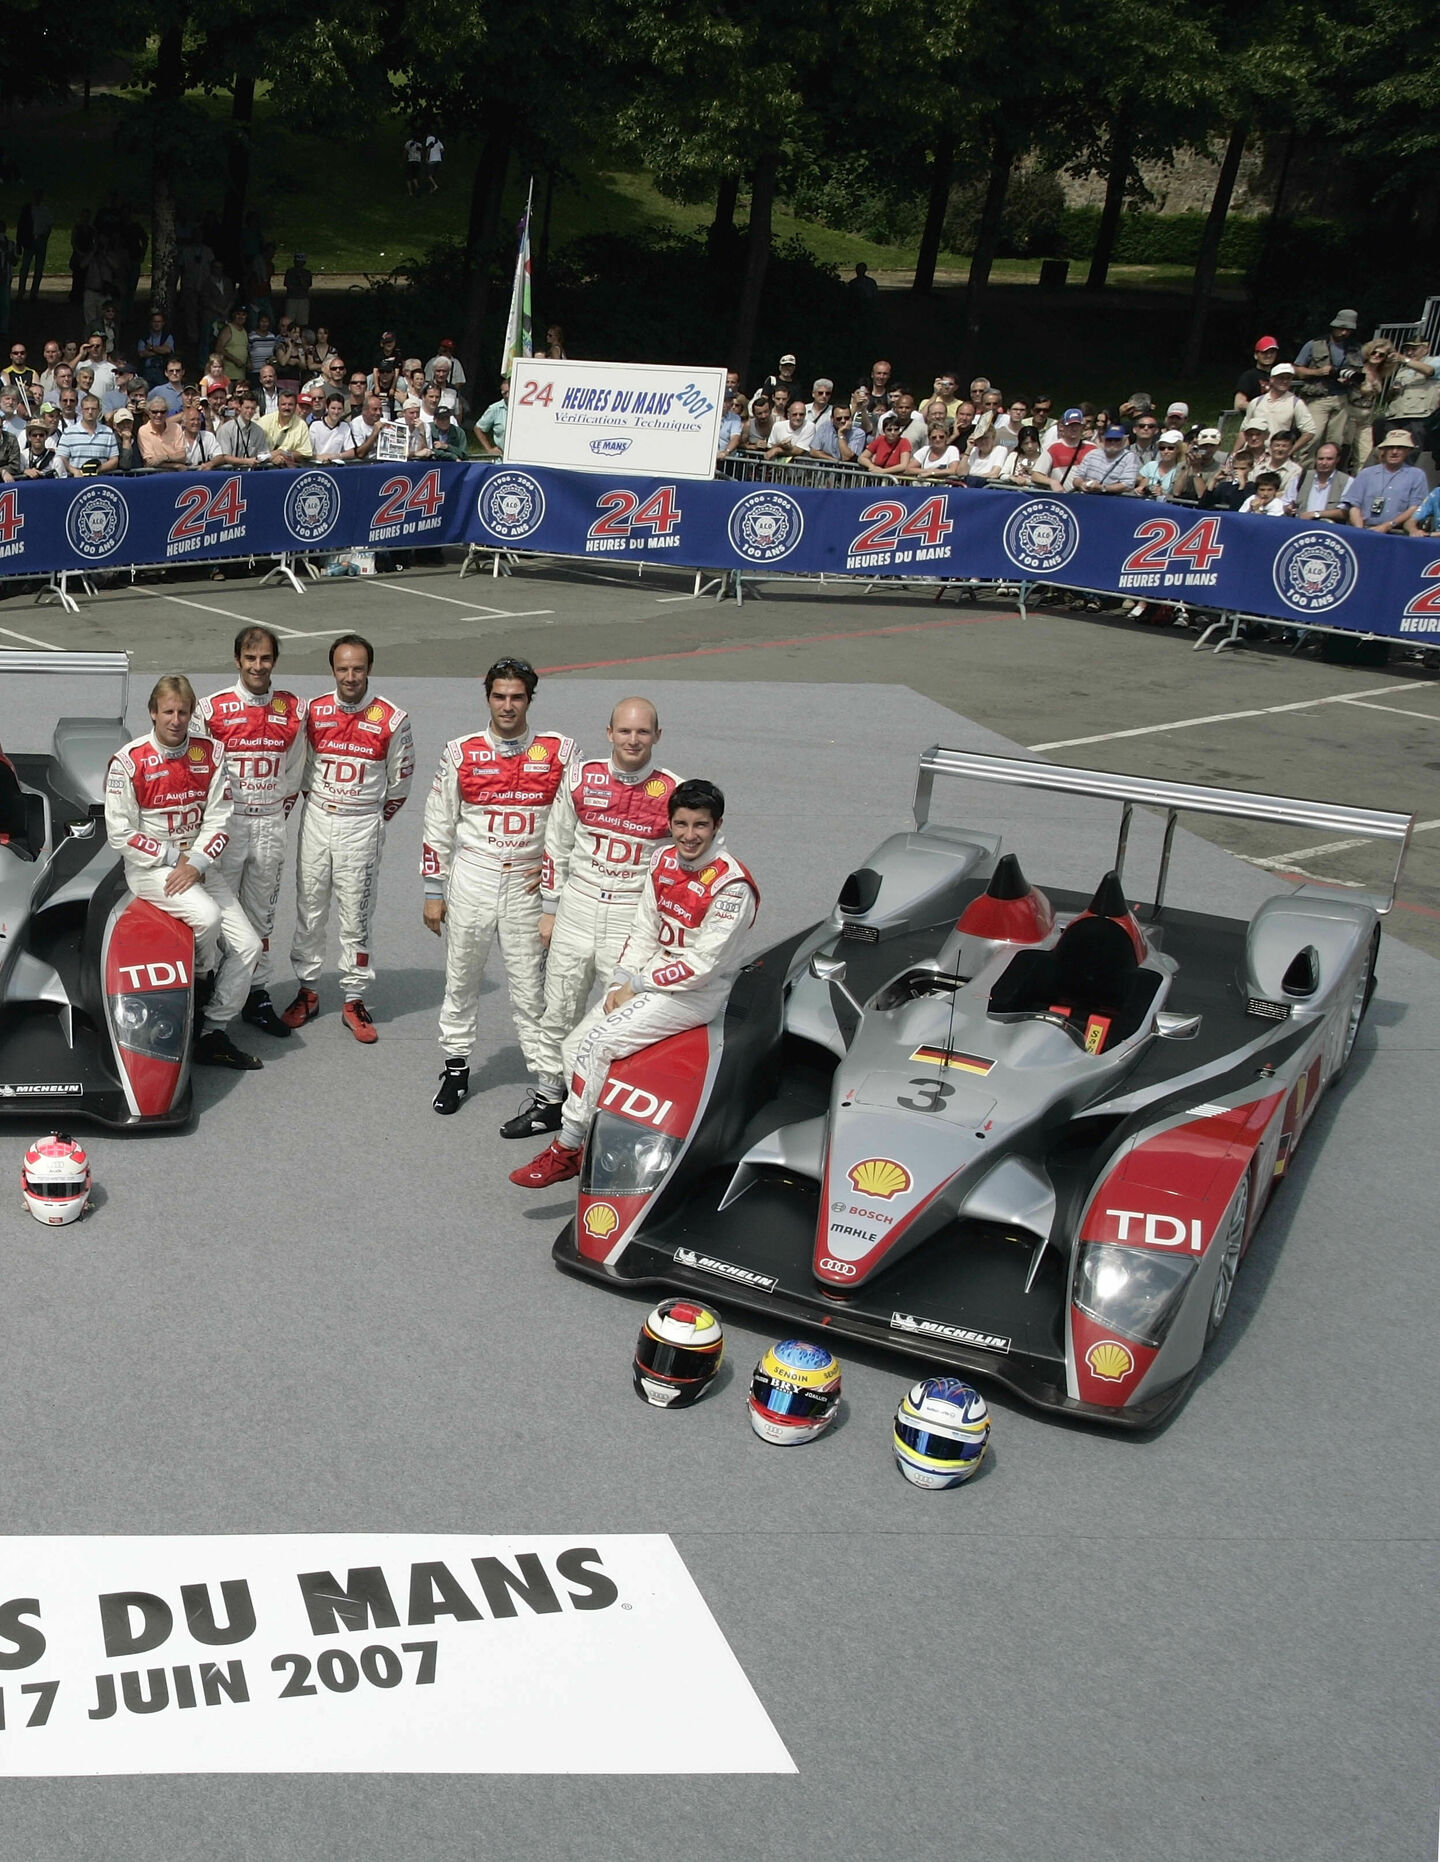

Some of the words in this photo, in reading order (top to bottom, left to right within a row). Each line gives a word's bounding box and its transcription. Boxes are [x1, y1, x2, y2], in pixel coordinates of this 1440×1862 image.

[519, 380, 554, 408] 24
[561, 387, 612, 412] HEURES
[611, 390, 634, 413] DU
[630, 391, 675, 416] MANS
[675, 383, 715, 420] 2007
[554, 412, 627, 426] Vérifications
[633, 416, 702, 432] Techniques
[592, 441, 601, 450] LE
[602, 441, 628, 451] MANS
[166, 475, 248, 543] 24
[370, 469, 445, 529] 24
[587, 485, 682, 539] 24
[368, 523, 401, 542] HEURES
[402, 521, 416, 534] DU
[417, 516, 442, 531] MANS
[848, 494, 954, 555] 24
[166, 535, 202, 556] HEURES
[204, 531, 218, 546] DU
[219, 525, 246, 541] MANS
[585, 537, 627, 552] HEURES
[629, 536, 645, 550] DU
[646, 535, 680, 548] MANS
[1120, 516, 1225, 574] 24
[846, 552, 891, 570] HEURES
[894, 550, 913, 563] DU
[916, 546, 951, 561] MANS
[1118, 573, 1160, 588] HEURES
[1163, 574, 1182, 586] DU
[1184, 573, 1217, 586] MANS
[1403, 559, 1440, 616] 2
[1400, 618, 1440, 632] HEUR
[219, 701, 245, 714] TDI
[314, 705, 337, 716] TDI
[239, 738, 261, 746] Audi
[263, 738, 284, 746] Sport
[327, 740, 347, 750] Audi
[348, 744, 373, 755] Sport
[140, 754, 164, 768] TDI
[469, 750, 496, 761] TDI
[232, 757, 281, 778] TDI
[320, 759, 367, 785] TDI
[239, 781, 277, 791] Power
[585, 773, 609, 785] TDI
[323, 782, 362, 797] Power
[491, 791, 514, 799] Audi
[515, 791, 544, 800] Sport
[483, 810, 535, 835] TDI
[597, 814, 621, 826] Audi
[622, 820, 653, 833] Sport
[137, 835, 162, 854] TDI
[207, 835, 227, 857] TDI
[488, 836, 530, 848] Power
[588, 831, 643, 866] TDI
[591, 859, 638, 879] Power
[119, 960, 188, 989] TDI
[654, 964, 686, 984] TDI
[576, 1026, 608, 1070] Audi
[606, 994, 651, 1026] Spor
[15, 1083, 80, 1094] MICHELIN
[897, 1078, 956, 1113] 3
[603, 1078, 674, 1125] TDI
[849, 1206, 893, 1225] BOSCH
[830, 1223, 877, 1243] MAHLE
[1106, 1209, 1203, 1251] TDI
[697, 1256, 774, 1288] MICHELIN
[918, 1318, 1008, 1348] MICHELIN
[770, 1378, 802, 1394] BRY
[98, 1579, 257, 1659] DU
[297, 1546, 620, 1638] MANS
[88, 1659, 251, 1722] JUIN
[270, 1640, 440, 1700] 2007
